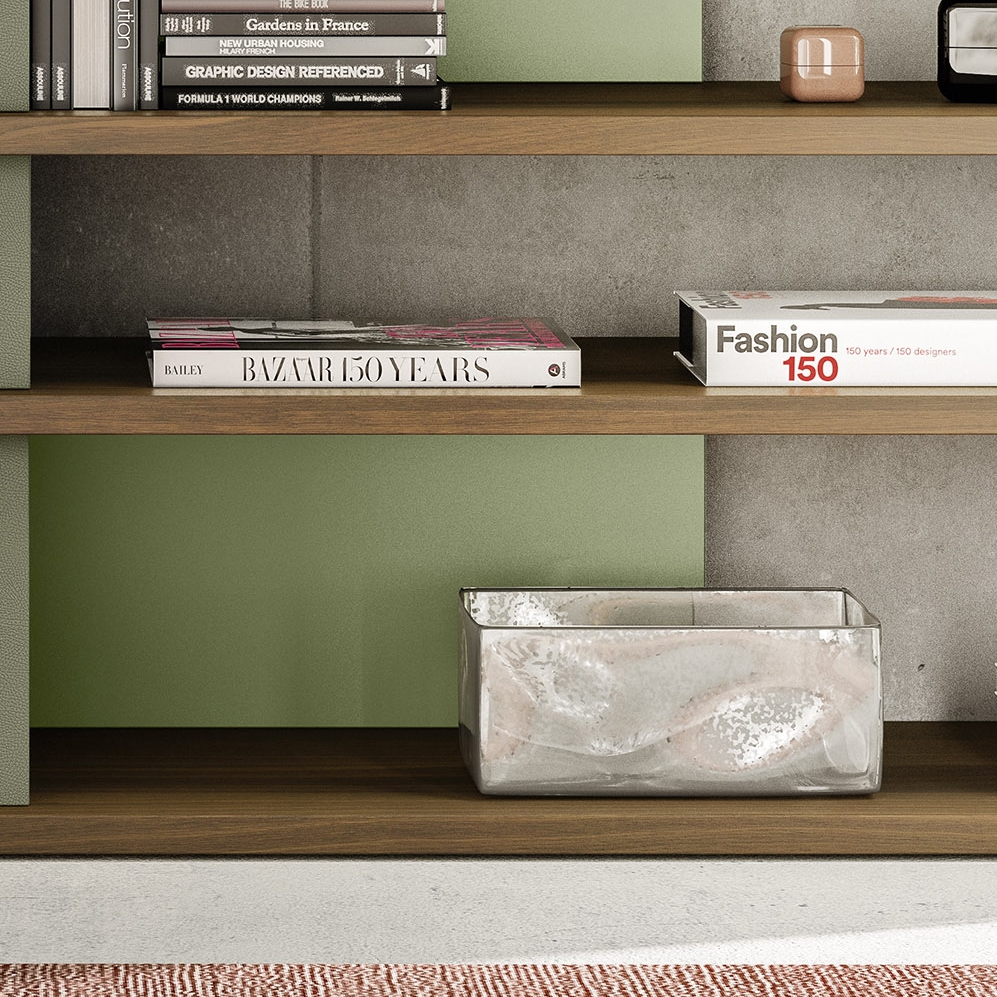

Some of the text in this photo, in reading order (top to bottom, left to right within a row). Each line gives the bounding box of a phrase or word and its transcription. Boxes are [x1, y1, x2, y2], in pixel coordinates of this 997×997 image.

[246, 18, 369, 31] Gardens in France
[219, 39, 325, 48] NEW URBAN HOUSING
[185, 65, 244, 79] GRAPHIC
[248, 65, 296, 79] DESIGN
[299, 65, 385, 79] REFERENCED
[717, 324, 838, 353] Fashion
[845, 347, 957, 358] 150 years 150 designers
[164, 364, 204, 376] BAILEY
[242, 356, 491, 383] BAZAAR 150 YEARS
[782, 356, 838, 382] 150
